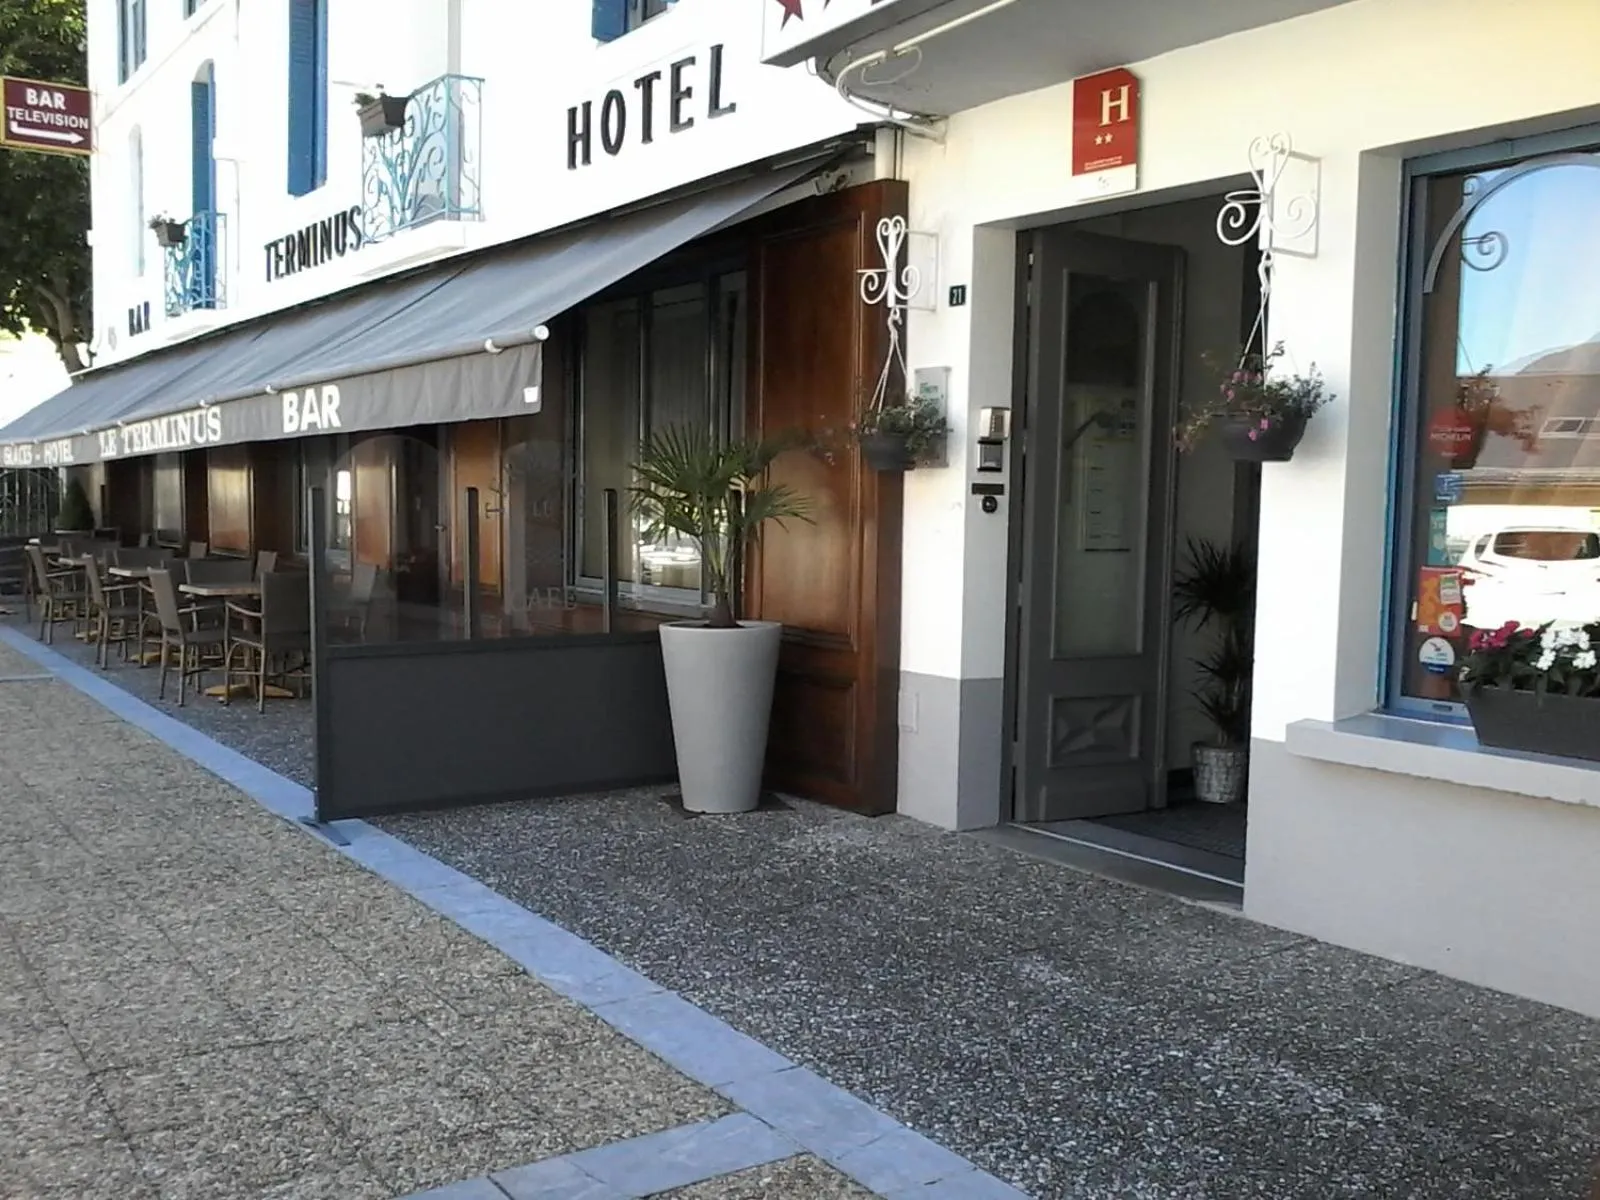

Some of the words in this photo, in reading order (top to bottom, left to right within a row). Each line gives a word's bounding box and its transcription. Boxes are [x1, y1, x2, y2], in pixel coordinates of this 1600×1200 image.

[6, 106, 89, 129] TELEVISION
[26, 88, 66, 110] BAR
[567, 44, 737, 170] HOTEL
[1099, 84, 1132, 127] H
[264, 205, 362, 283] TERMINUS
[128, 301, 150, 337] BAR
[44, 438, 74, 465] HOTEL
[99, 430, 117, 458] LE
[121, 406, 222, 455] TERMINUS
[282, 384, 342, 434] BAR
